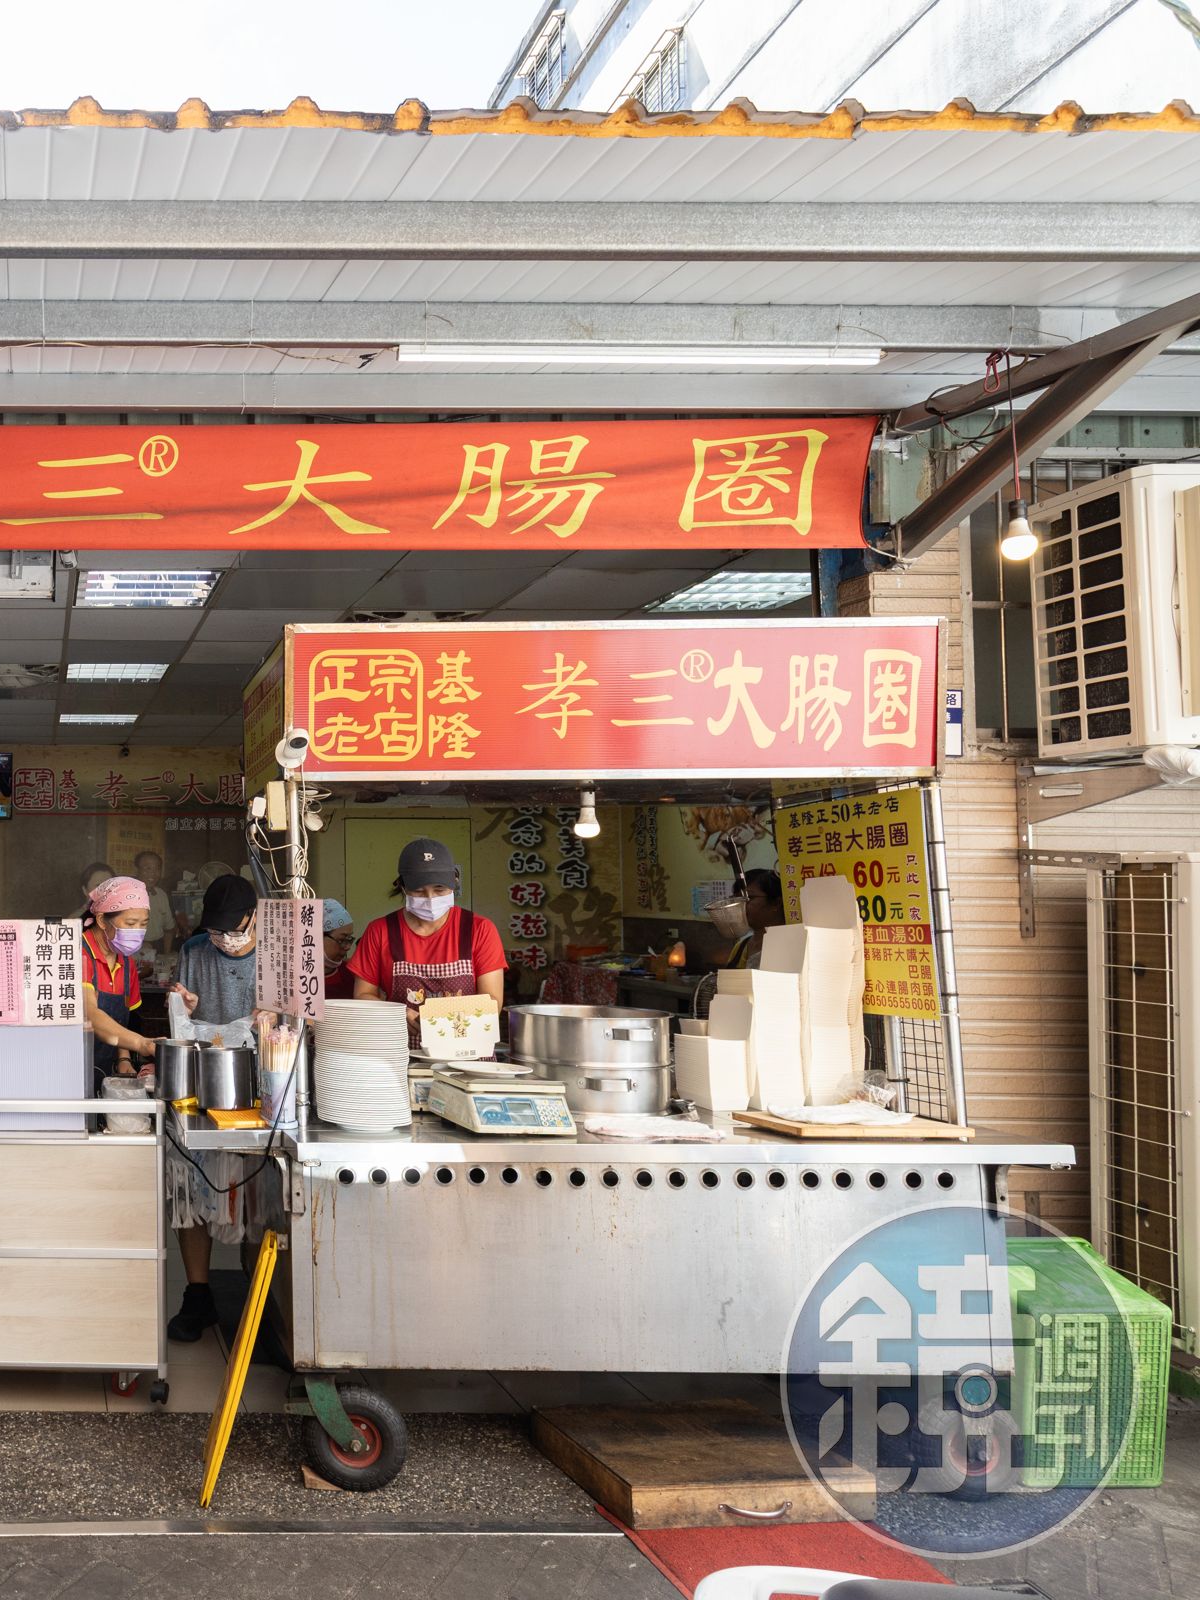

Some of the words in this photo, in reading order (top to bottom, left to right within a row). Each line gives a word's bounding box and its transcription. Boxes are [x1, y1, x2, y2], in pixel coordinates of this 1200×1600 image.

[314, 655, 417, 704] 正宗
[427, 650, 482, 760] 基隆
[314, 706, 419, 756] 老店
[787, 822, 909, 858] 孝三路大腸圈
[853, 859, 901, 889] 60元
[905, 854, 922, 921] 只此一家
[35, 924, 54, 1021] 外帶不用填
[58, 924, 76, 1020] 內用請填單
[299, 904, 319, 1017] 豬血湯30元
